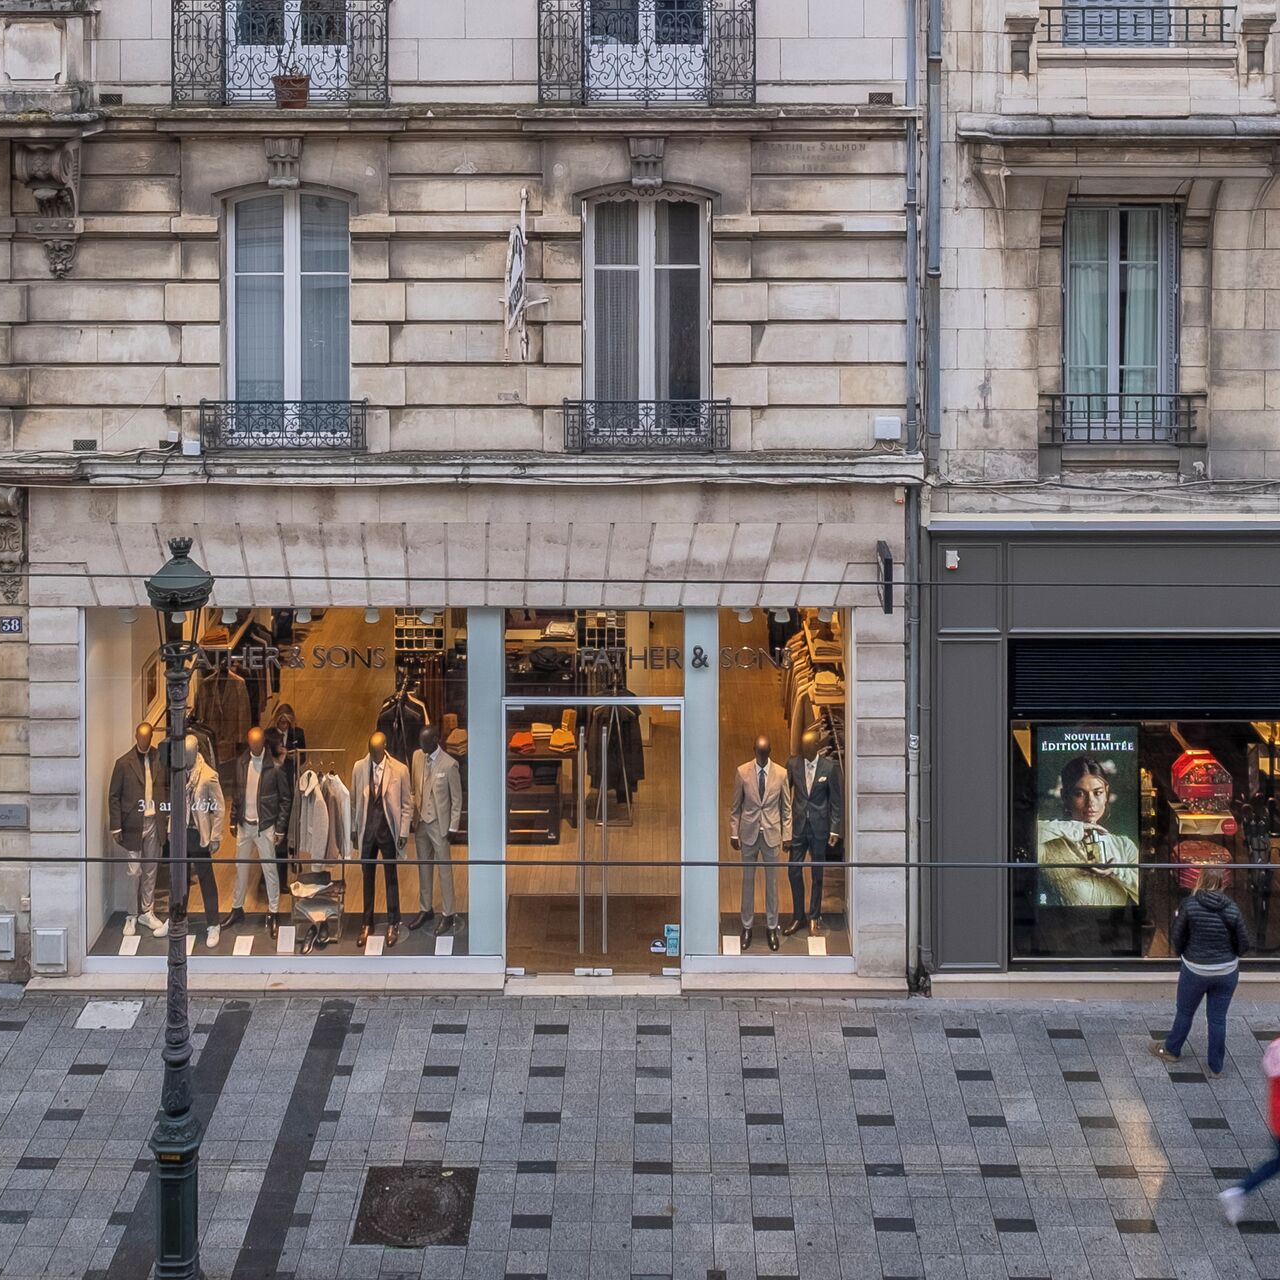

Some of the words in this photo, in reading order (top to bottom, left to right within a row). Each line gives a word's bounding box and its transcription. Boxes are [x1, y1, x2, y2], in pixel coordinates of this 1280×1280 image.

[2, 618, 19, 632] 38
[290, 646, 305, 669] &
[312, 645, 386, 669] SONS
[581, 647, 683, 670] FATHER
[691, 645, 709, 669] &
[719, 646, 793, 670] SONS
[1064, 733, 1111, 741] NOUVELLE
[1041, 740, 1087, 751] ÉDITION
[1091, 740, 1134, 751] LIMITÉE
[138, 800, 156, 812] 30
